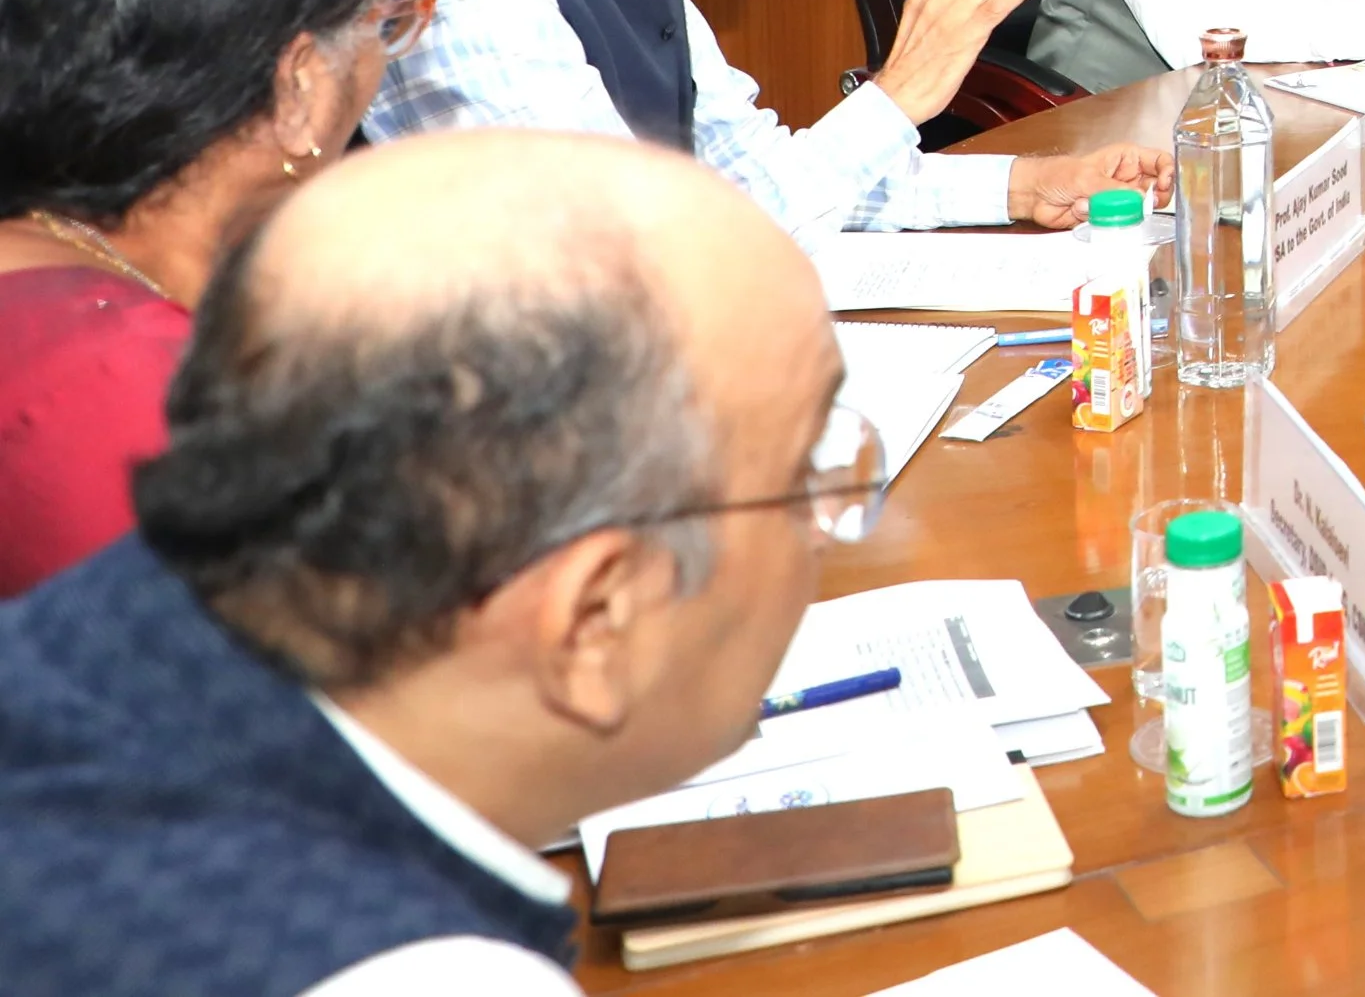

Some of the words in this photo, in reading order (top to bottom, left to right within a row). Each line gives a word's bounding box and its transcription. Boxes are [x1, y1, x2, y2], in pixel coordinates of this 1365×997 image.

[1274, 241, 1286, 263] SA
[1287, 238, 1295, 254] to
[1296, 227, 1307, 246] the
[1308, 210, 1326, 235] Govt.
[1328, 201, 1335, 221] of
[1336, 190, 1351, 214] India
[1275, 204, 1291, 232] Prof.
[1293, 194, 1307, 218] Ajay
[1308, 177, 1331, 204] Kumar
